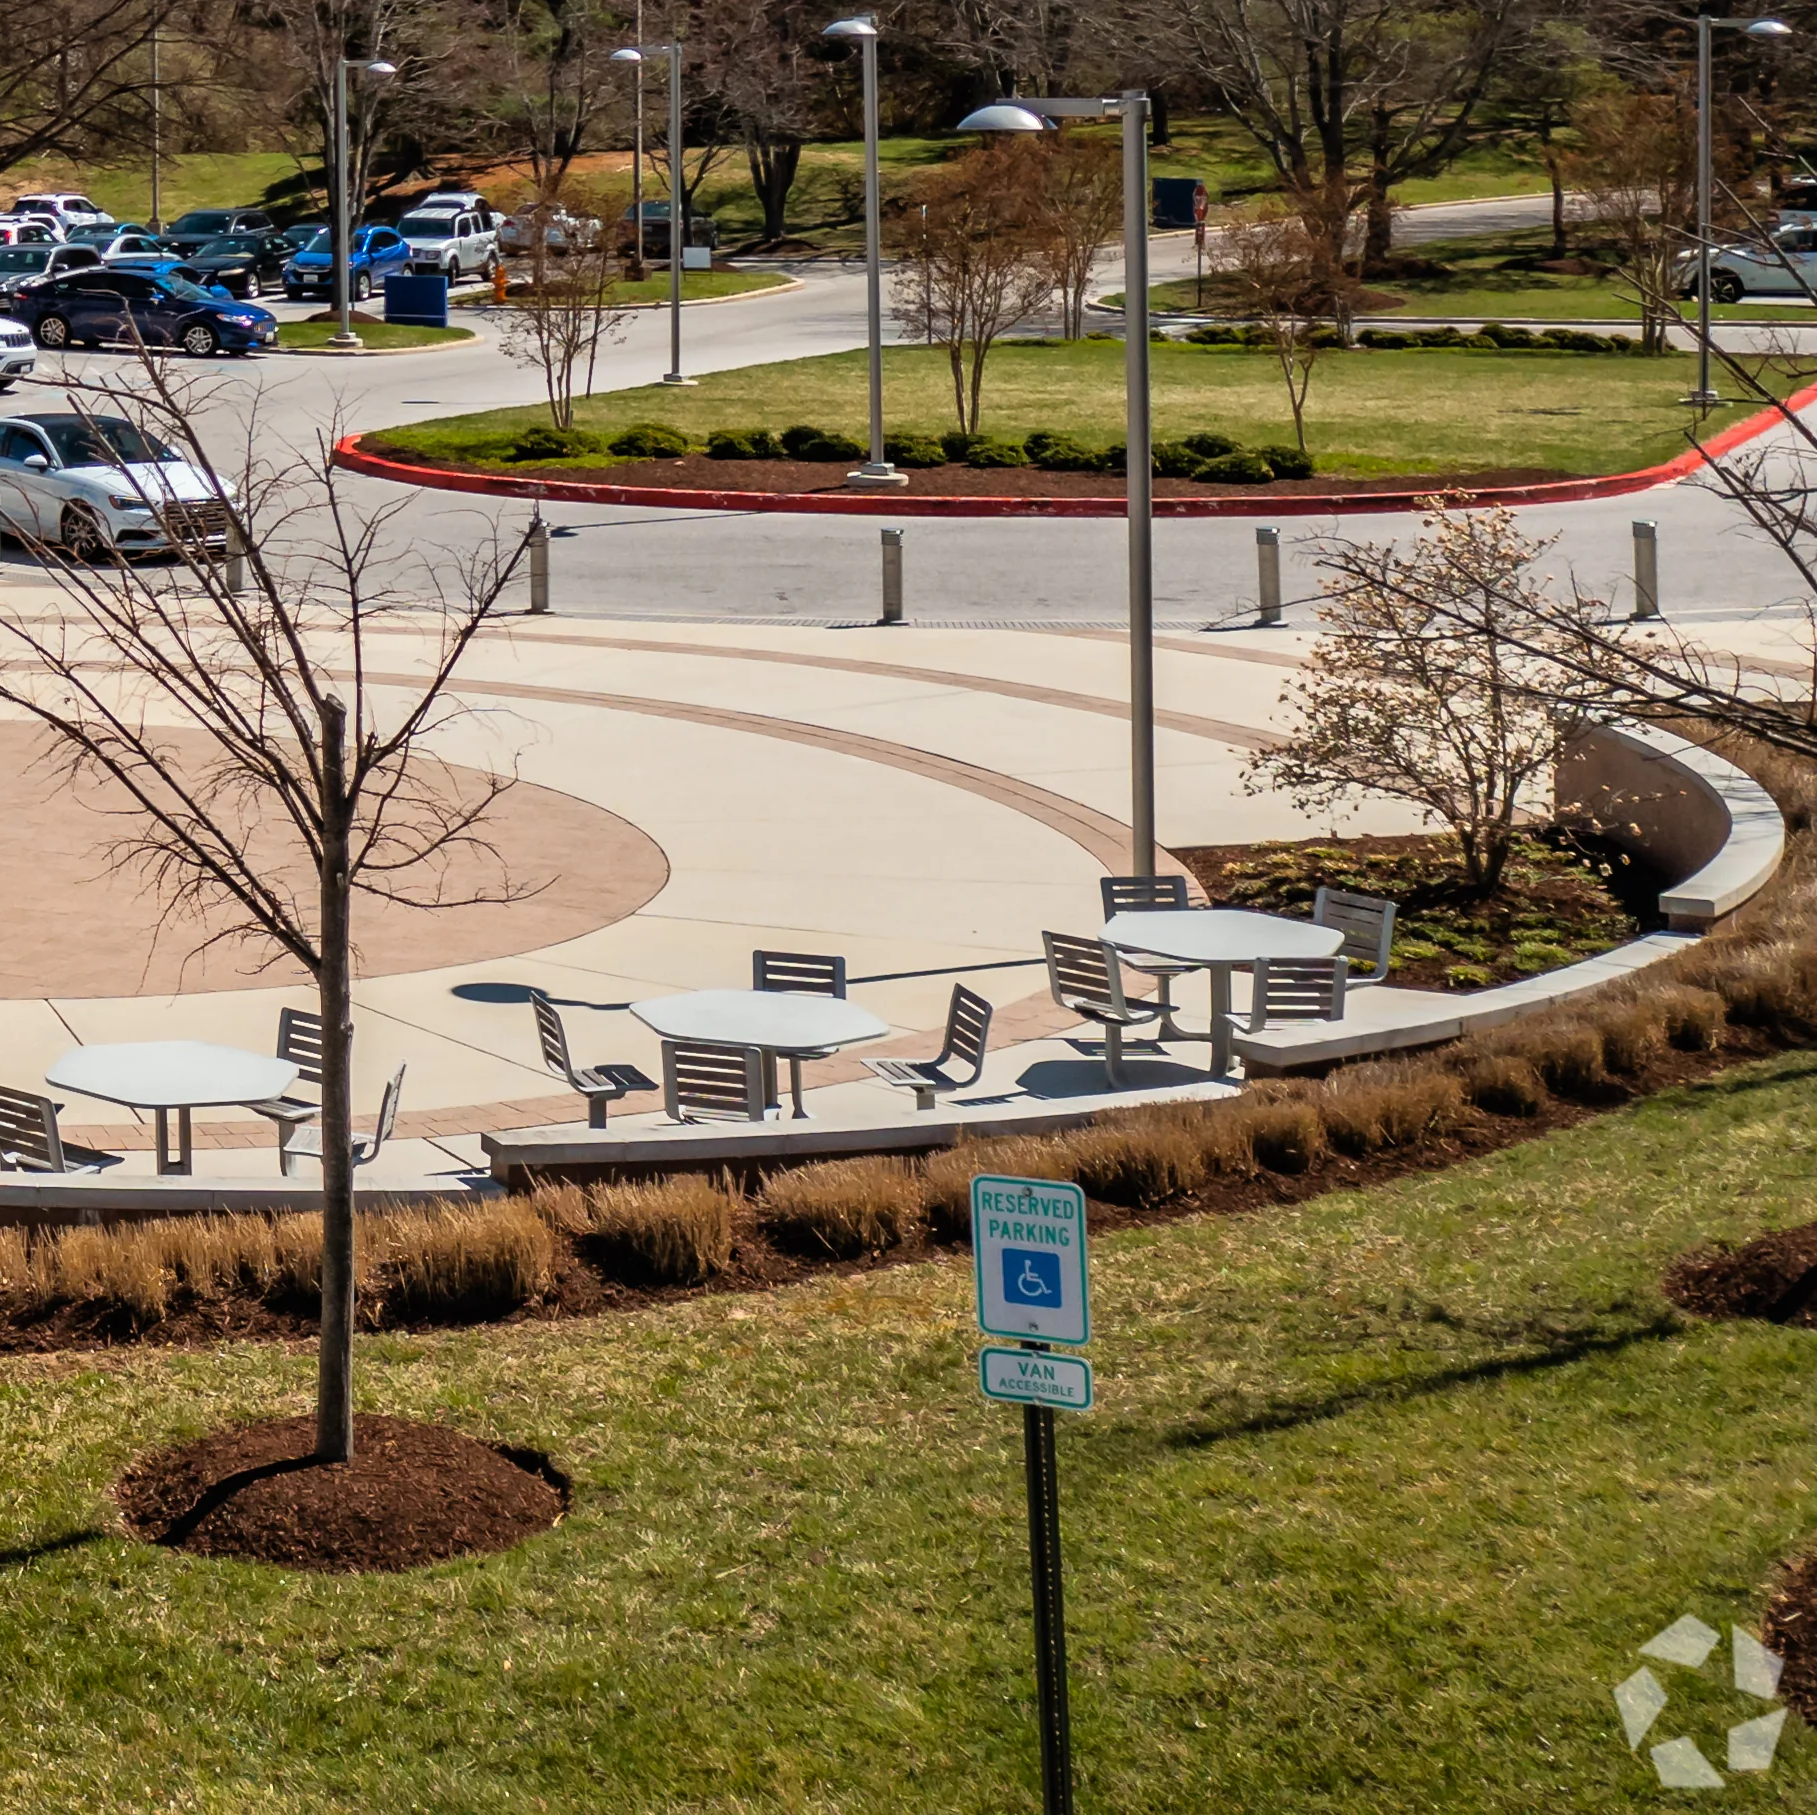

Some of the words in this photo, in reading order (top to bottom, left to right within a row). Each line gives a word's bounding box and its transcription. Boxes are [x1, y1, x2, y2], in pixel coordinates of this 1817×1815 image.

[981, 1191, 1075, 1220] RESERVED
[988, 1220, 1070, 1247] PARKING
[1017, 1362, 1055, 1381] VAN
[998, 1378, 1075, 1397] ACCESSIBLE
